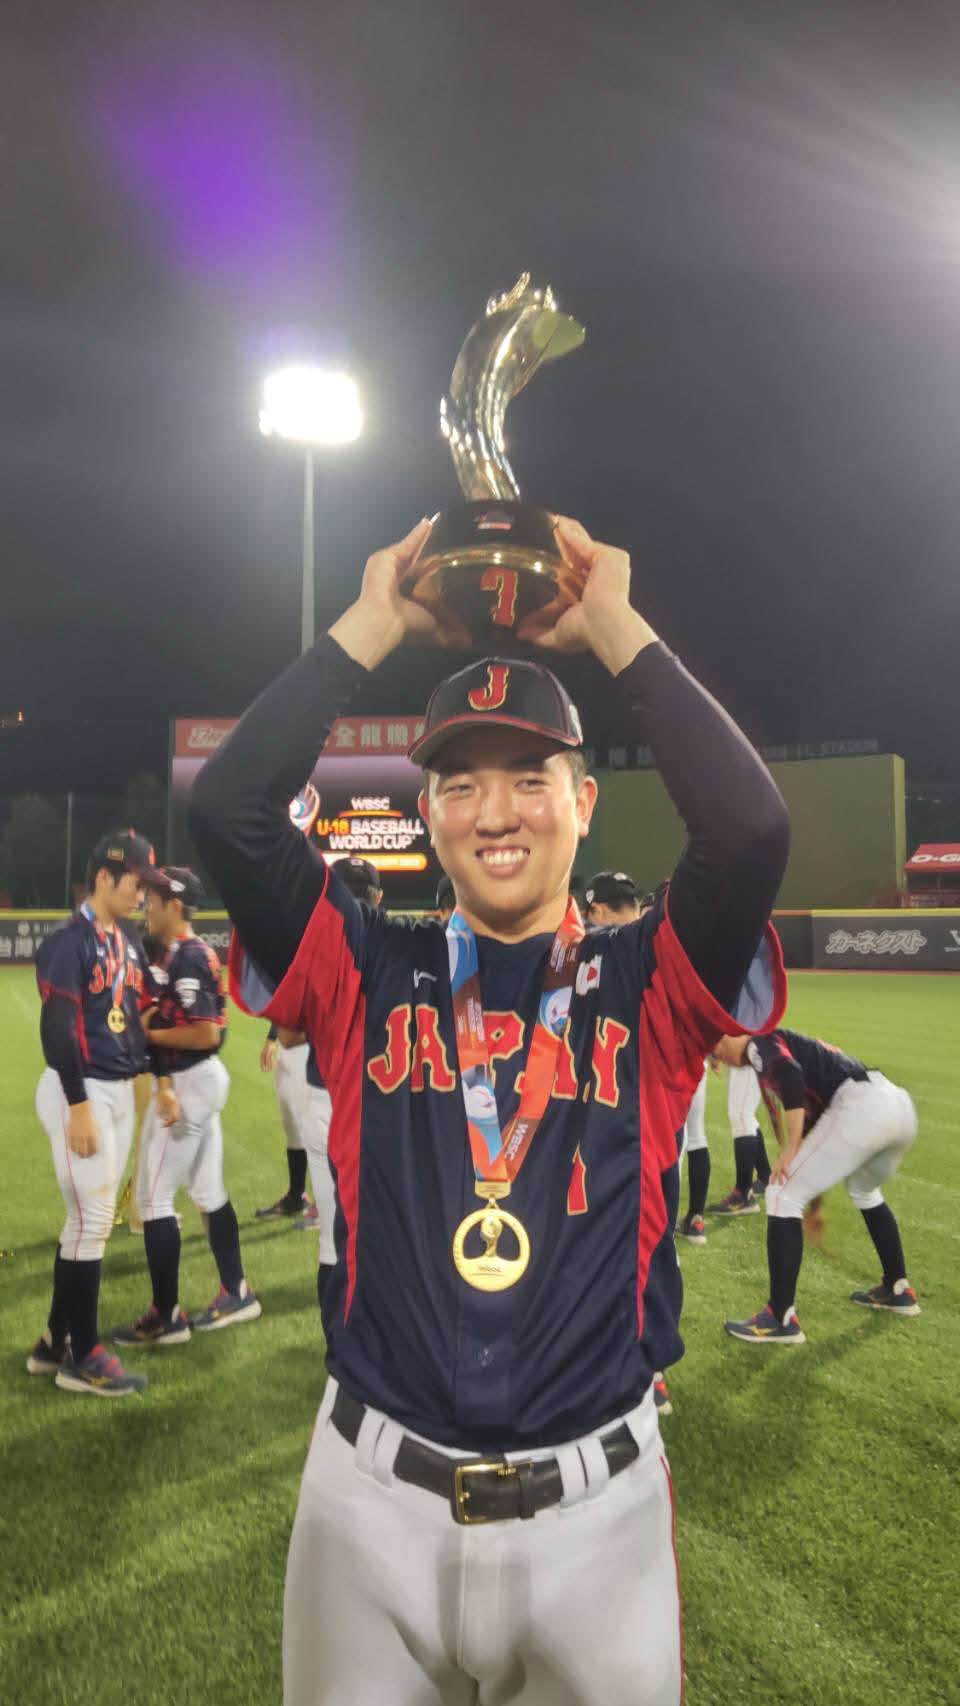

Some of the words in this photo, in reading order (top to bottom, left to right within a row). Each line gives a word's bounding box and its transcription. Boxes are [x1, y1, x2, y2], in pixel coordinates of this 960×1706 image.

[467, 665, 510, 711] J
[351, 797, 391, 810] WBSC
[317, 818, 350, 836] U-18
[351, 818, 425, 836] BASEBALL
[329, 834, 383, 850] WORLD
[825, 929, 928, 955] カーネクスト
